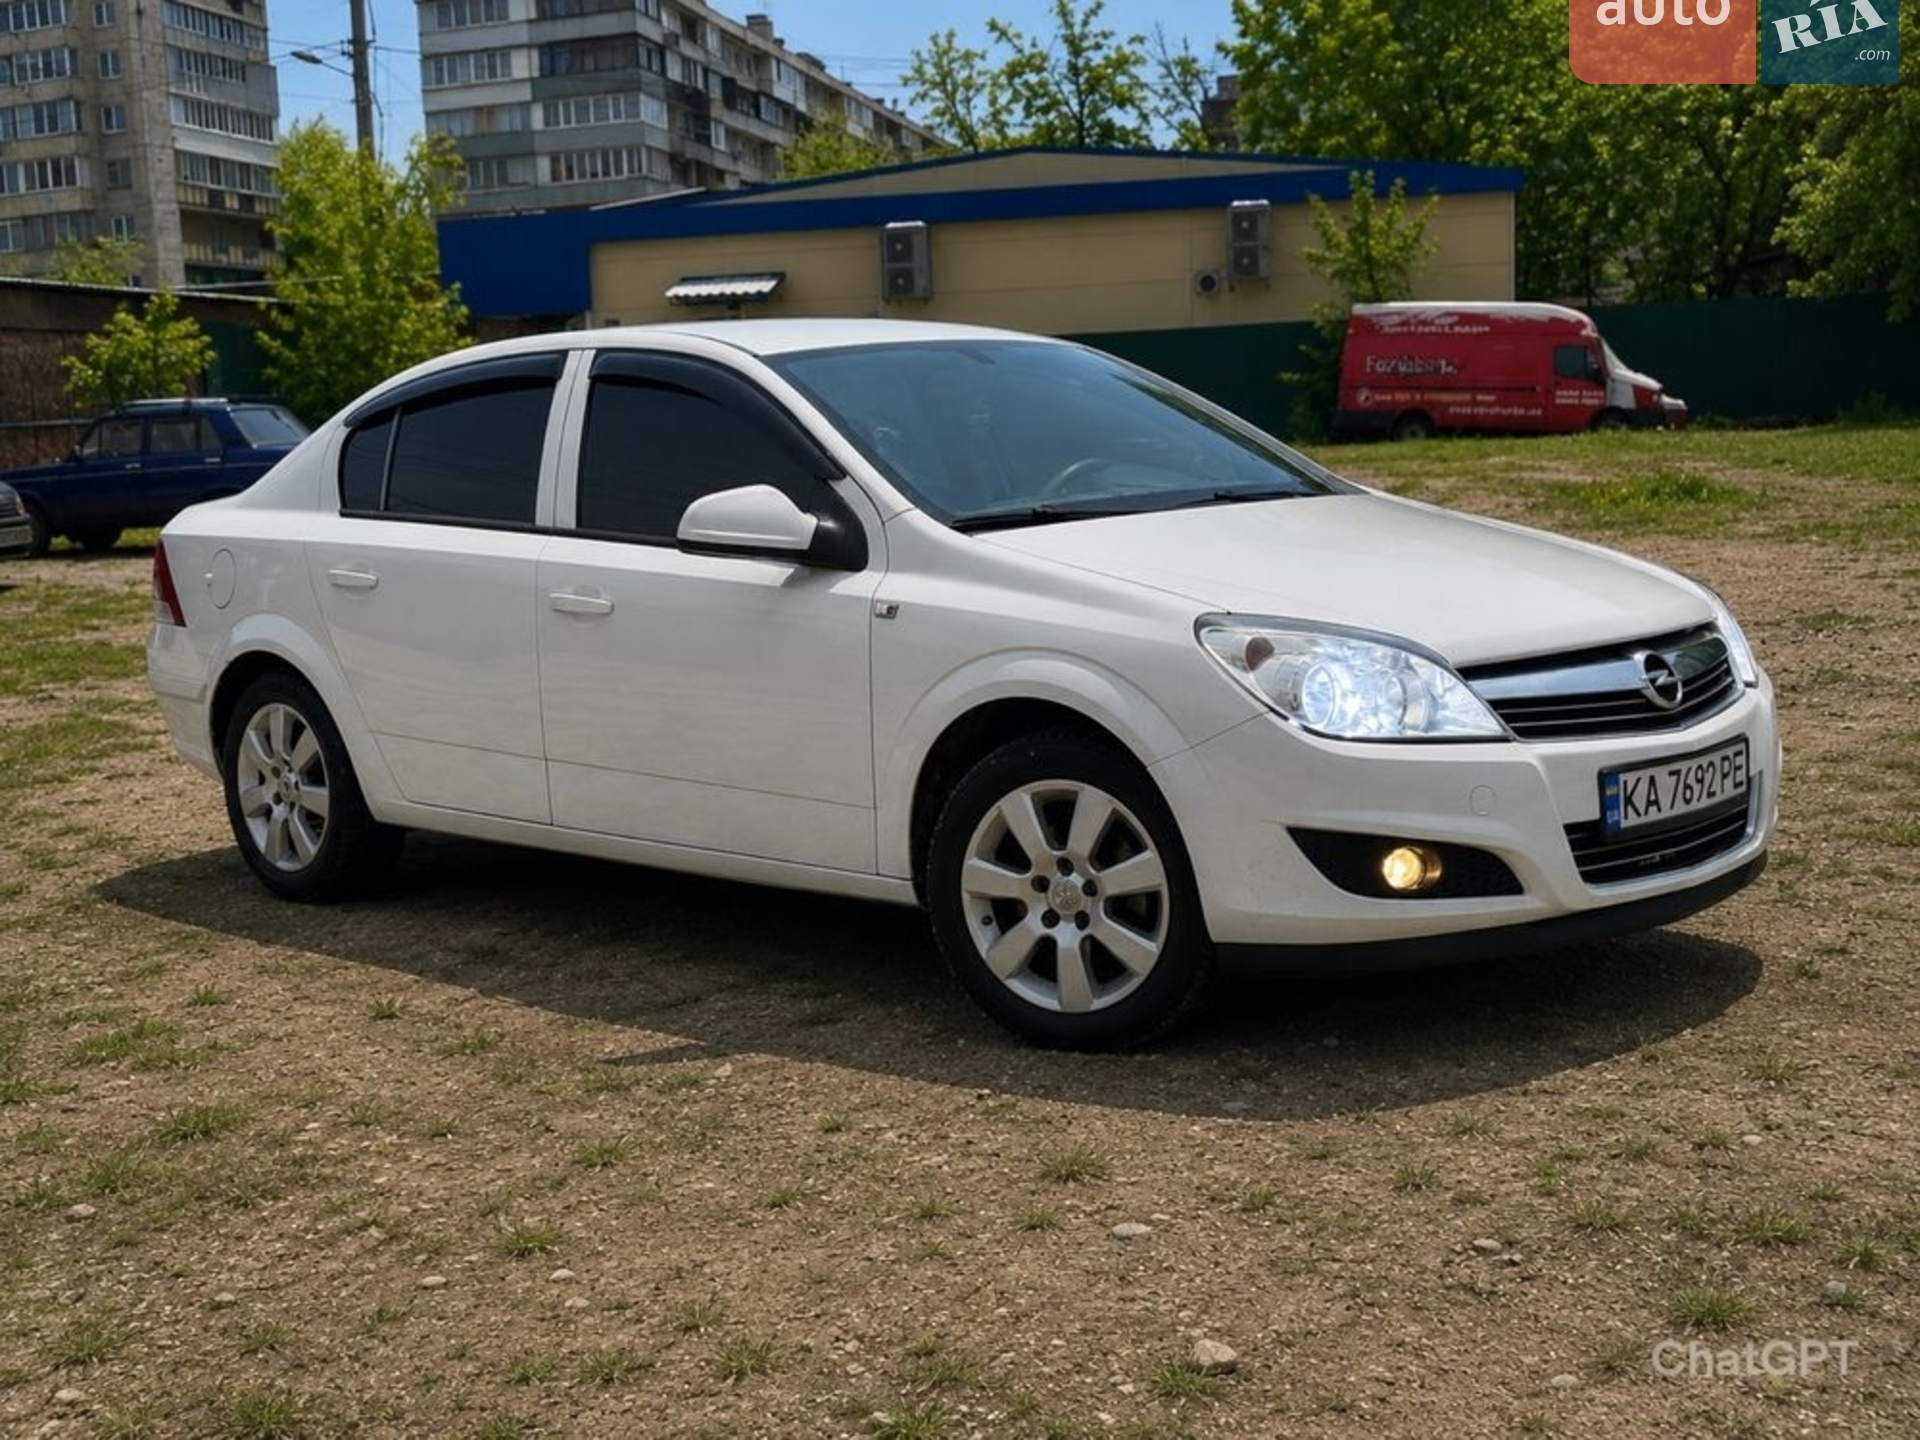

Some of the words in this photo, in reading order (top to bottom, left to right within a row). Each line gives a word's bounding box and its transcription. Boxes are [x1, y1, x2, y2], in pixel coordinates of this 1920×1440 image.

[1623, 774, 1661, 820] KA
[1668, 760, 1716, 810] 7692
[1720, 750, 1744, 793] PE
